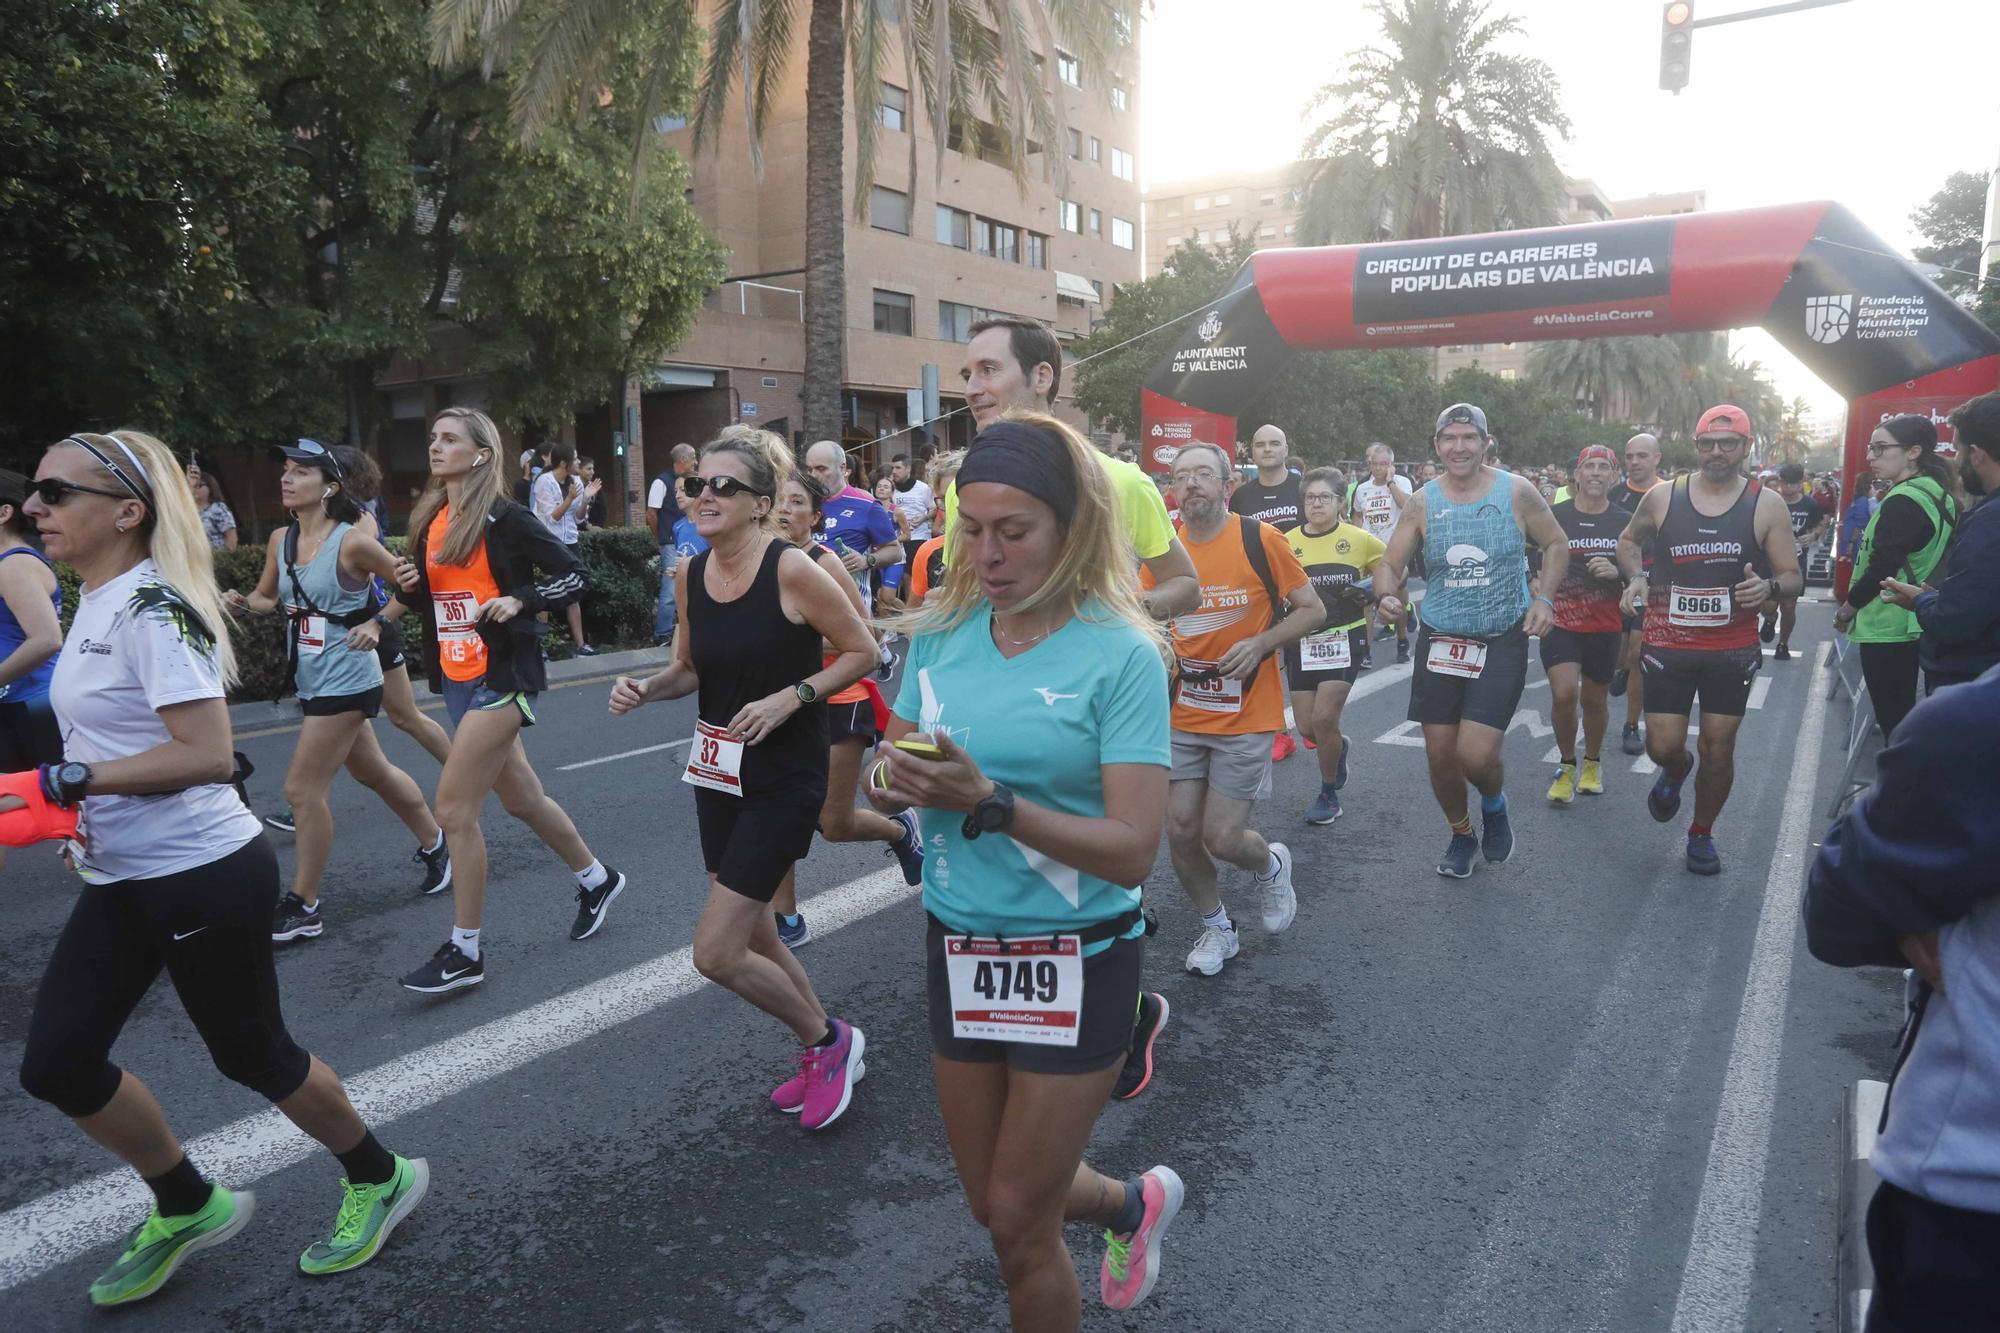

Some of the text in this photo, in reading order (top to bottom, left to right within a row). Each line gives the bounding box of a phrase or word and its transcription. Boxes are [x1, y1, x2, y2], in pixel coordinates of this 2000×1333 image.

[1366, 242, 1598, 274] CIRCUIT DE CARRERES
[1391, 257, 1654, 293] POPULARS DE VALÈNCIA
[1859, 295, 1924, 306] Fundació
[1533, 309, 1654, 325] #ValènciaCorre
[1858, 306, 1927, 318] Esportiva
[1857, 316, 1929, 328] Municipal
[1856, 328, 1918, 340] València
[1175, 346, 1246, 360] AJUNTAMENT
[1172, 359, 1247, 372] DE VALÈNCIA
[1218, 595, 1248, 608] 2018
[1678, 596, 1722, 613] 6968
[443, 601, 467, 621] 361
[1309, 643, 1342, 658] 4687
[1449, 644, 1467, 660] 47
[701, 737, 720, 767] 32
[973, 960, 1058, 1003] 4749
[989, 1012, 1044, 1023] #ValènciaCorre
